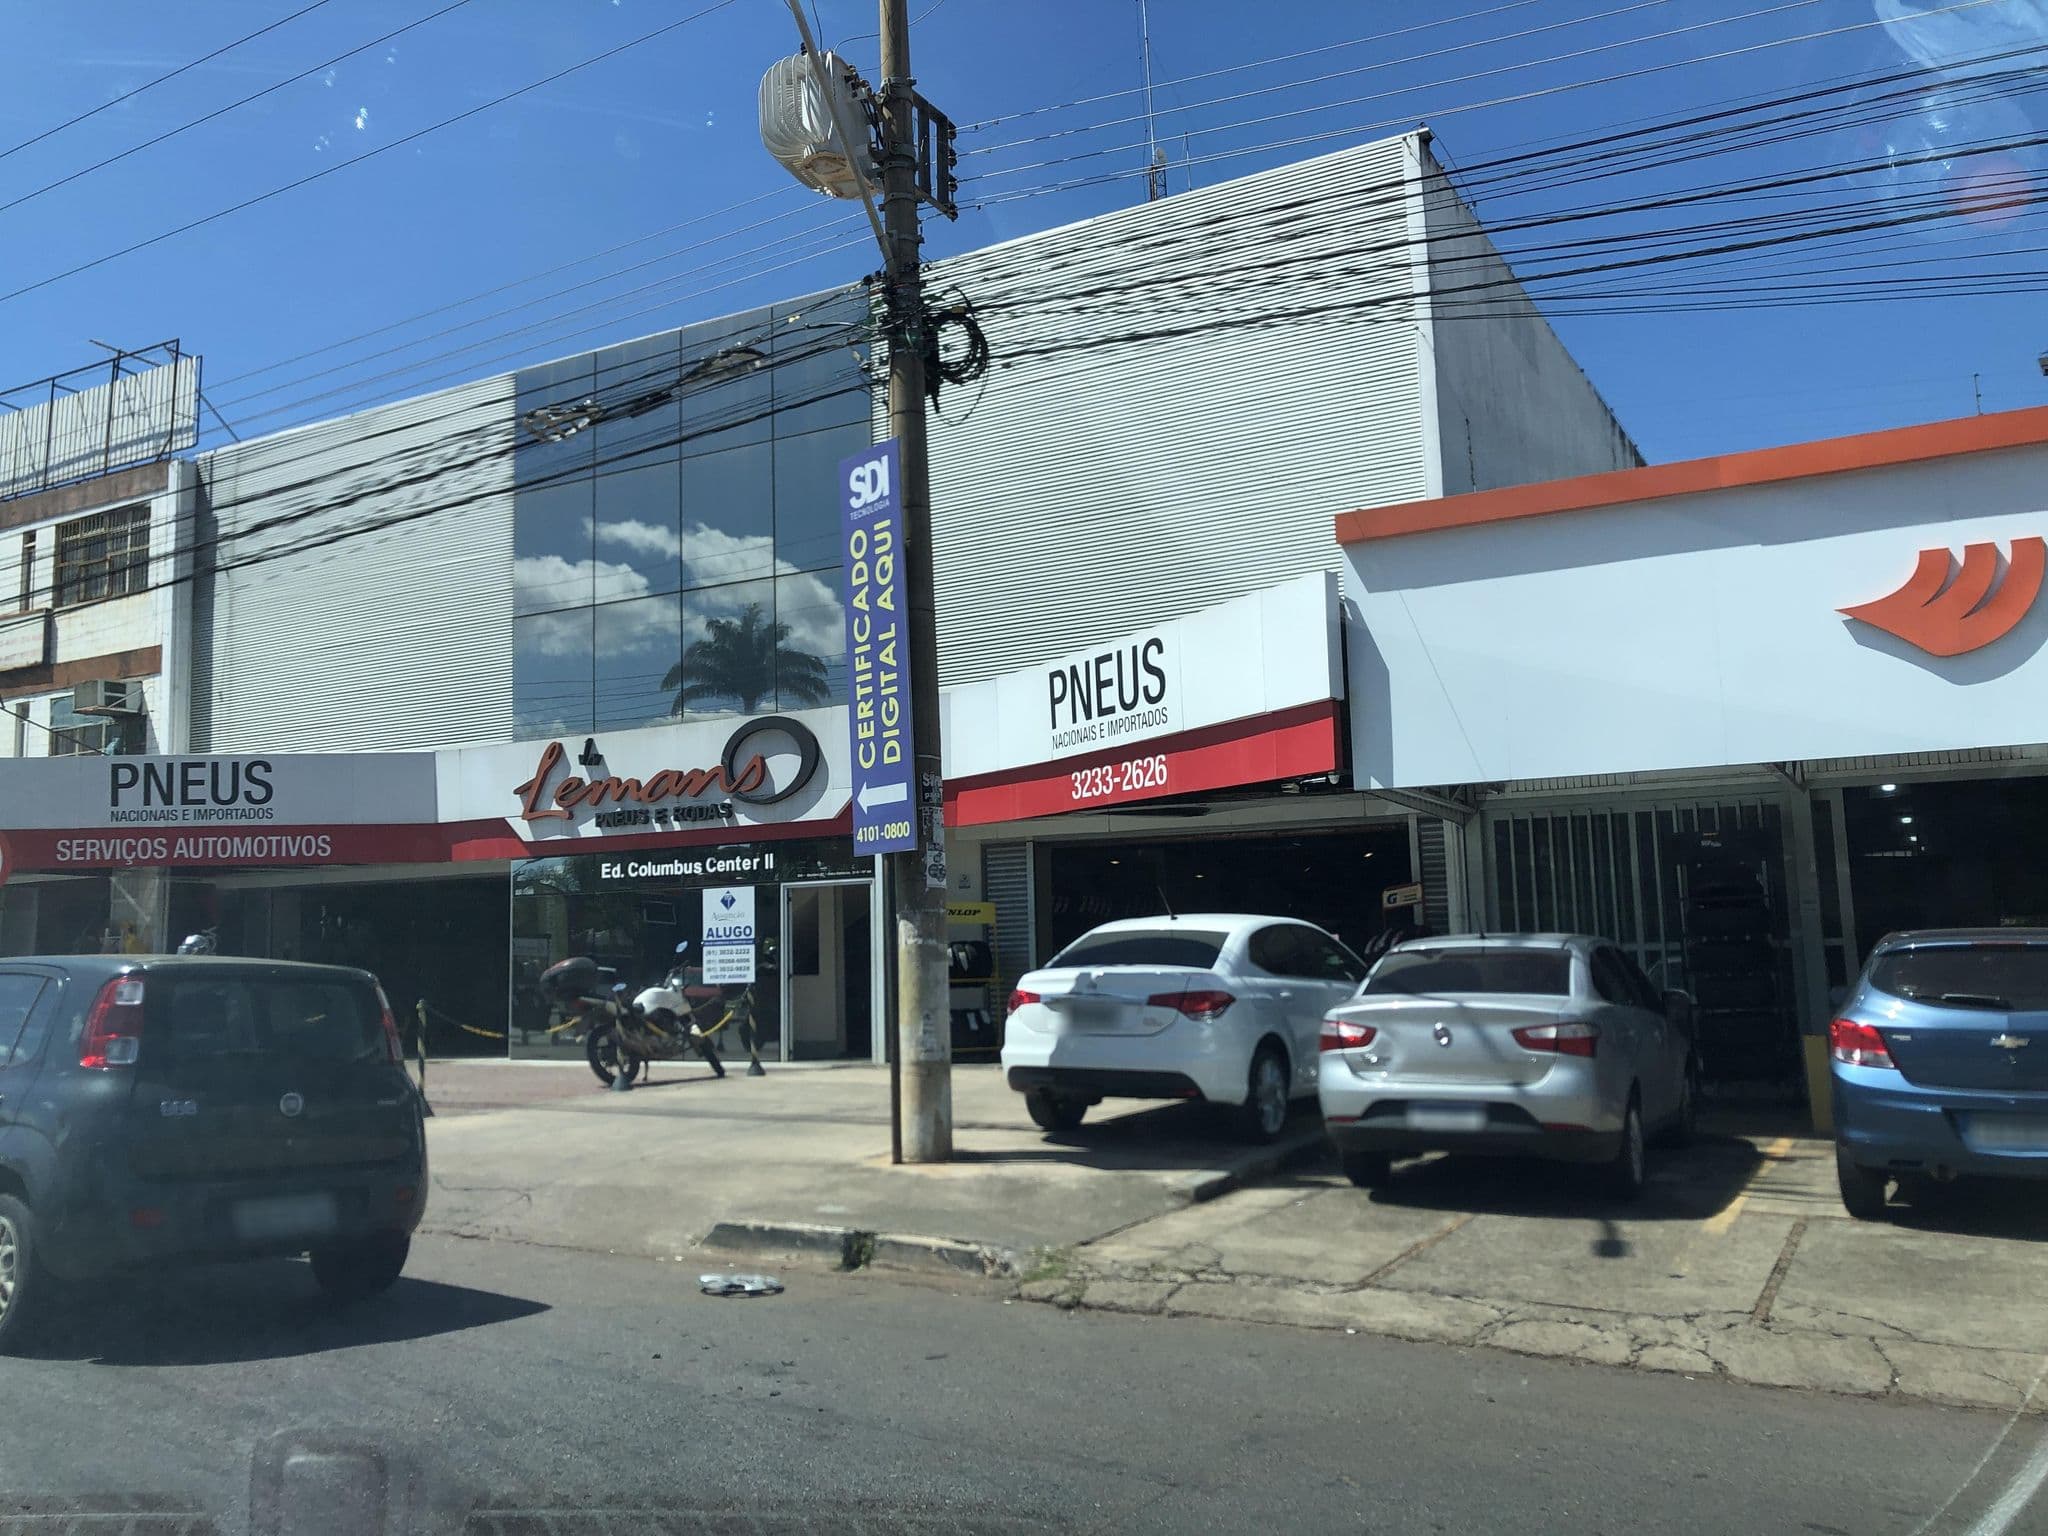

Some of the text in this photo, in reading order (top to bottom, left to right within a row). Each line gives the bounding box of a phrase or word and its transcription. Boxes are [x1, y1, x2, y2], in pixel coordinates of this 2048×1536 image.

[849, 455, 890, 509] SDI
[850, 499, 891, 521] TECNOLOGIA
[850, 529, 876, 770] CERTIFICADO
[873, 519, 901, 765] DIGITAL AQUI
[1049, 637, 1166, 730] PNEUS
[1052, 707, 1168, 750] NACIONAIS E IMPORTADOS
[111, 760, 274, 807] PNEUS
[1071, 754, 1167, 800] 3233-2626
[110, 808, 274, 822] NACIONAIS E IMPORTADOS
[595, 802, 733, 828] PNEUS E RODAS
[856, 821, 910, 843] 4101-0800
[56, 835, 331, 865] SERVIÇOS AUTOMOTIVOS
[601, 863, 625, 880] Ed.
[628, 858, 702, 878] Columbus
[705, 856, 760, 874] Center
[706, 925, 753, 939] ALUGO
